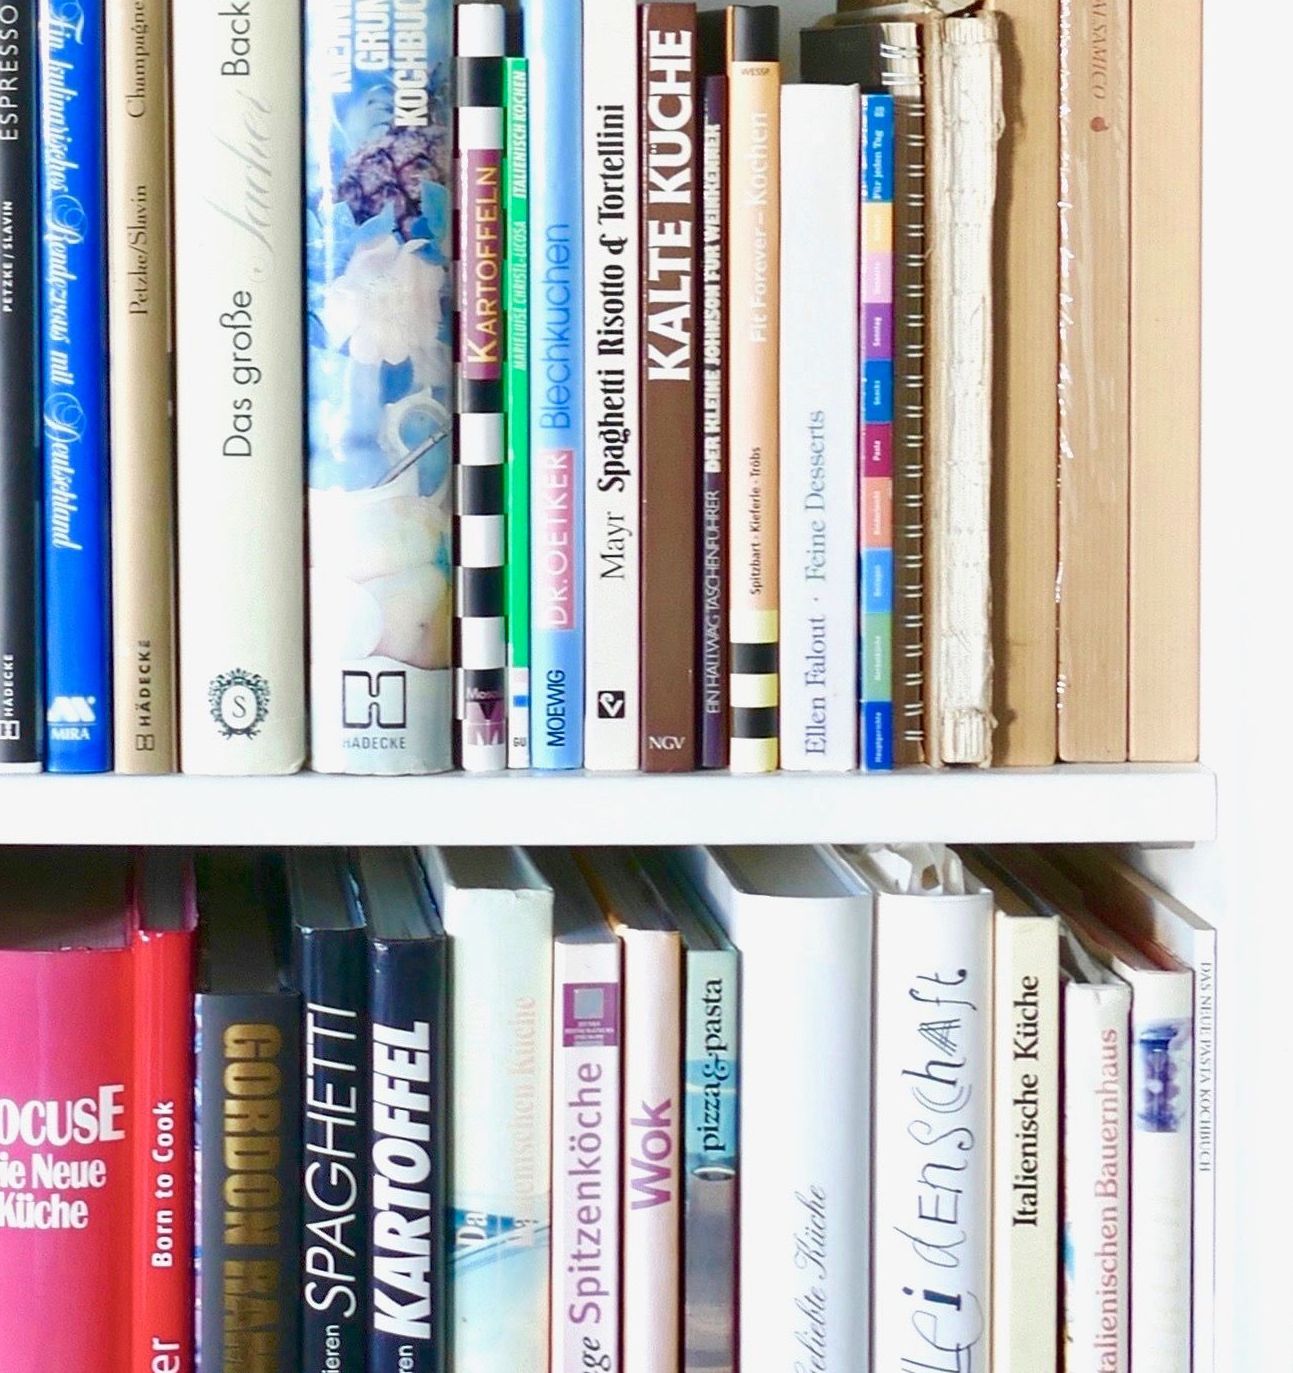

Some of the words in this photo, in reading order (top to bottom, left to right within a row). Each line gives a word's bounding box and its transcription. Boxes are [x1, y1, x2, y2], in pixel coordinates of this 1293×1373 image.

[0, 4, 19, 141] ESPRESSO
[648, 30, 690, 203] KÜCHE
[597, 106, 624, 219] Tortellini
[598, 265, 623, 355] Risotto
[648, 221, 690, 380] KALTE
[598, 370, 630, 492] Spaghetti
[805, 411, 824, 509] Desserts
[601, 511, 632, 578] Mayr
[805, 521, 825, 579] Feine
[805, 619, 825, 684] Falout
[546, 669, 567, 747] MOEWIG
[805, 698, 826, 753] Ellen
[1014, 976, 1038, 1059] Küche
[33, 1149, 108, 1187] Neue
[153, 1103, 172, 1161] Cook
[305, 1003, 356, 1317] SPAGHETTI
[626, 1093, 672, 1216] Wok
[1013, 1074, 1037, 1225] Italienische
[154, 1176, 175, 1199] to
[374, 1021, 432, 1339] KARTOFFEL
[568, 1063, 609, 1324] Spitzenköche
[151, 1208, 175, 1267] Born
